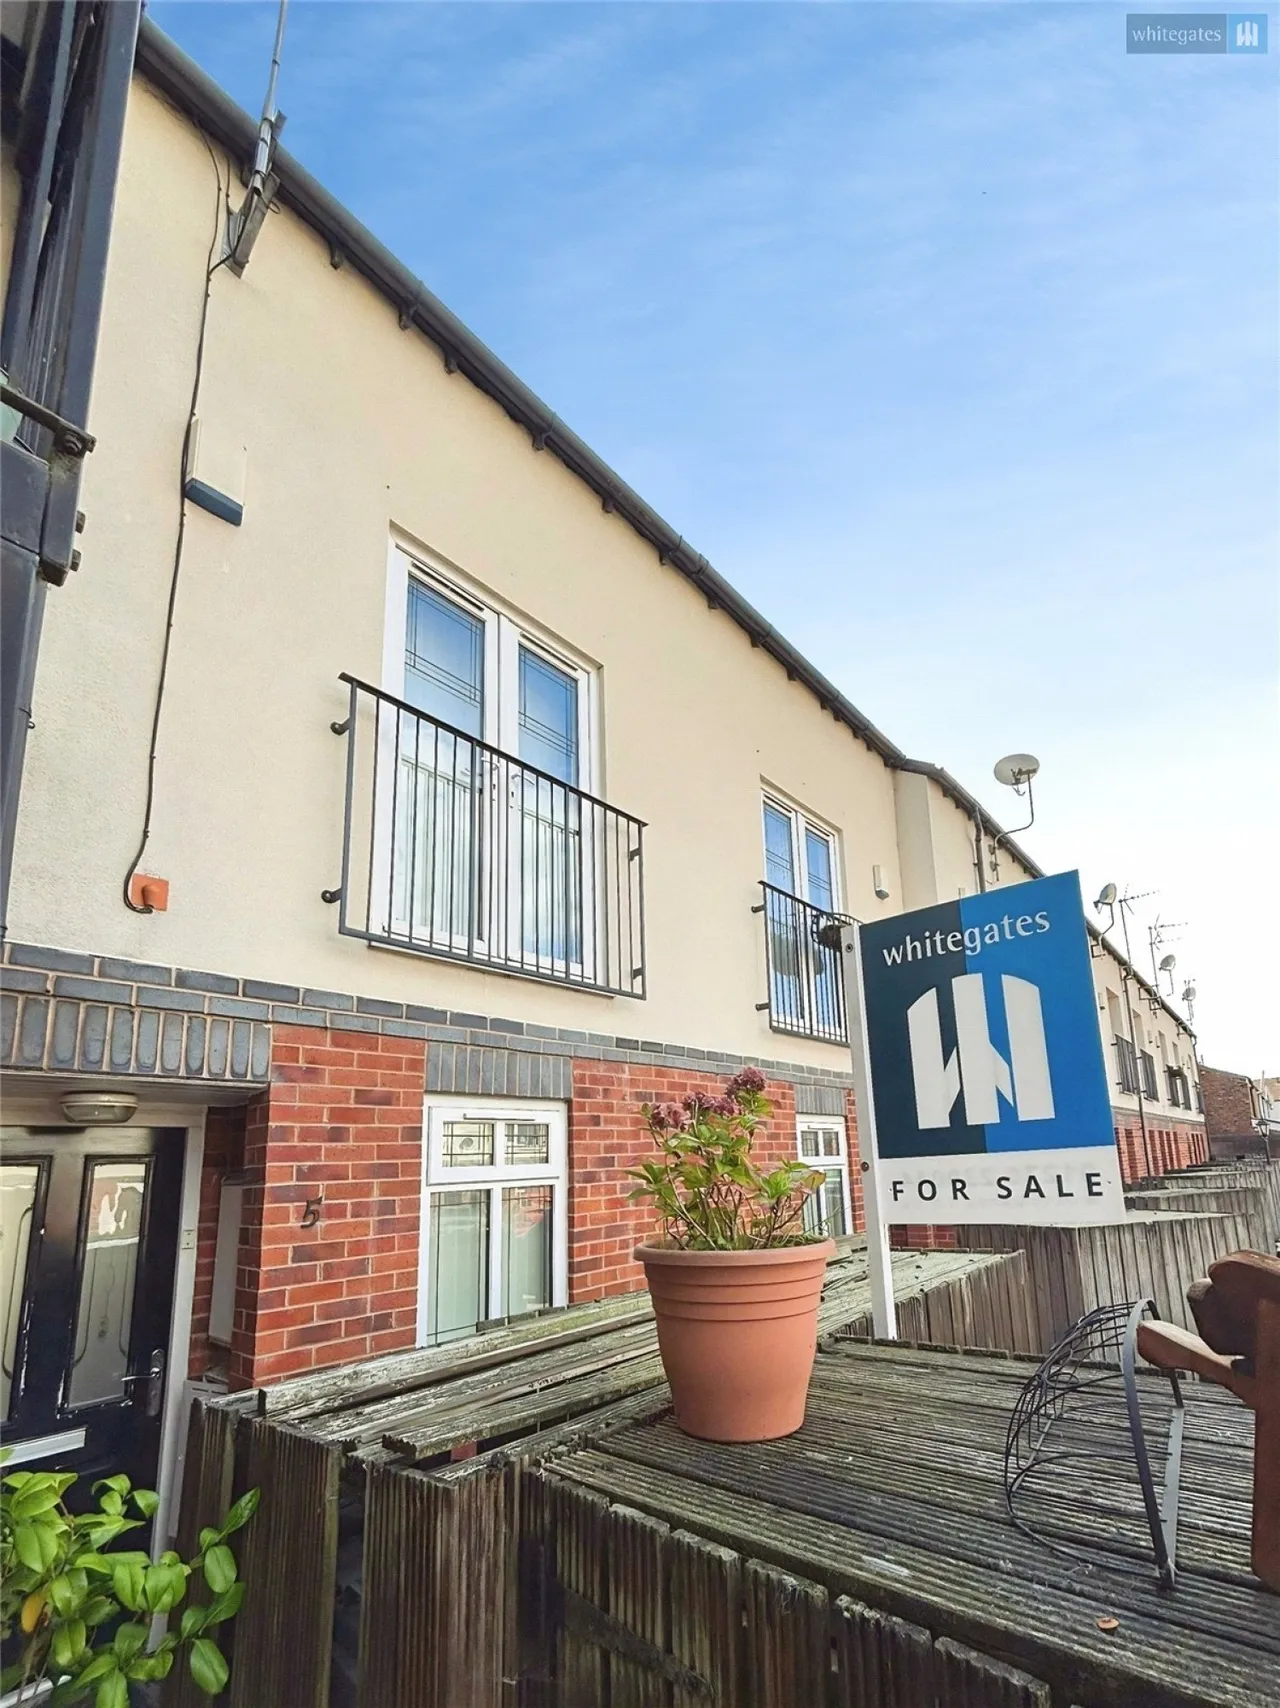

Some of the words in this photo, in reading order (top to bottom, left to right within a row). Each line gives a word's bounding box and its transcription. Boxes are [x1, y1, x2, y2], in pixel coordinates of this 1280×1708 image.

[883, 911, 1050, 966] whitegates
[892, 1178, 970, 1201] FOR
[996, 1172, 1104, 1199] SALE
[301, 1196, 323, 1229] 5
